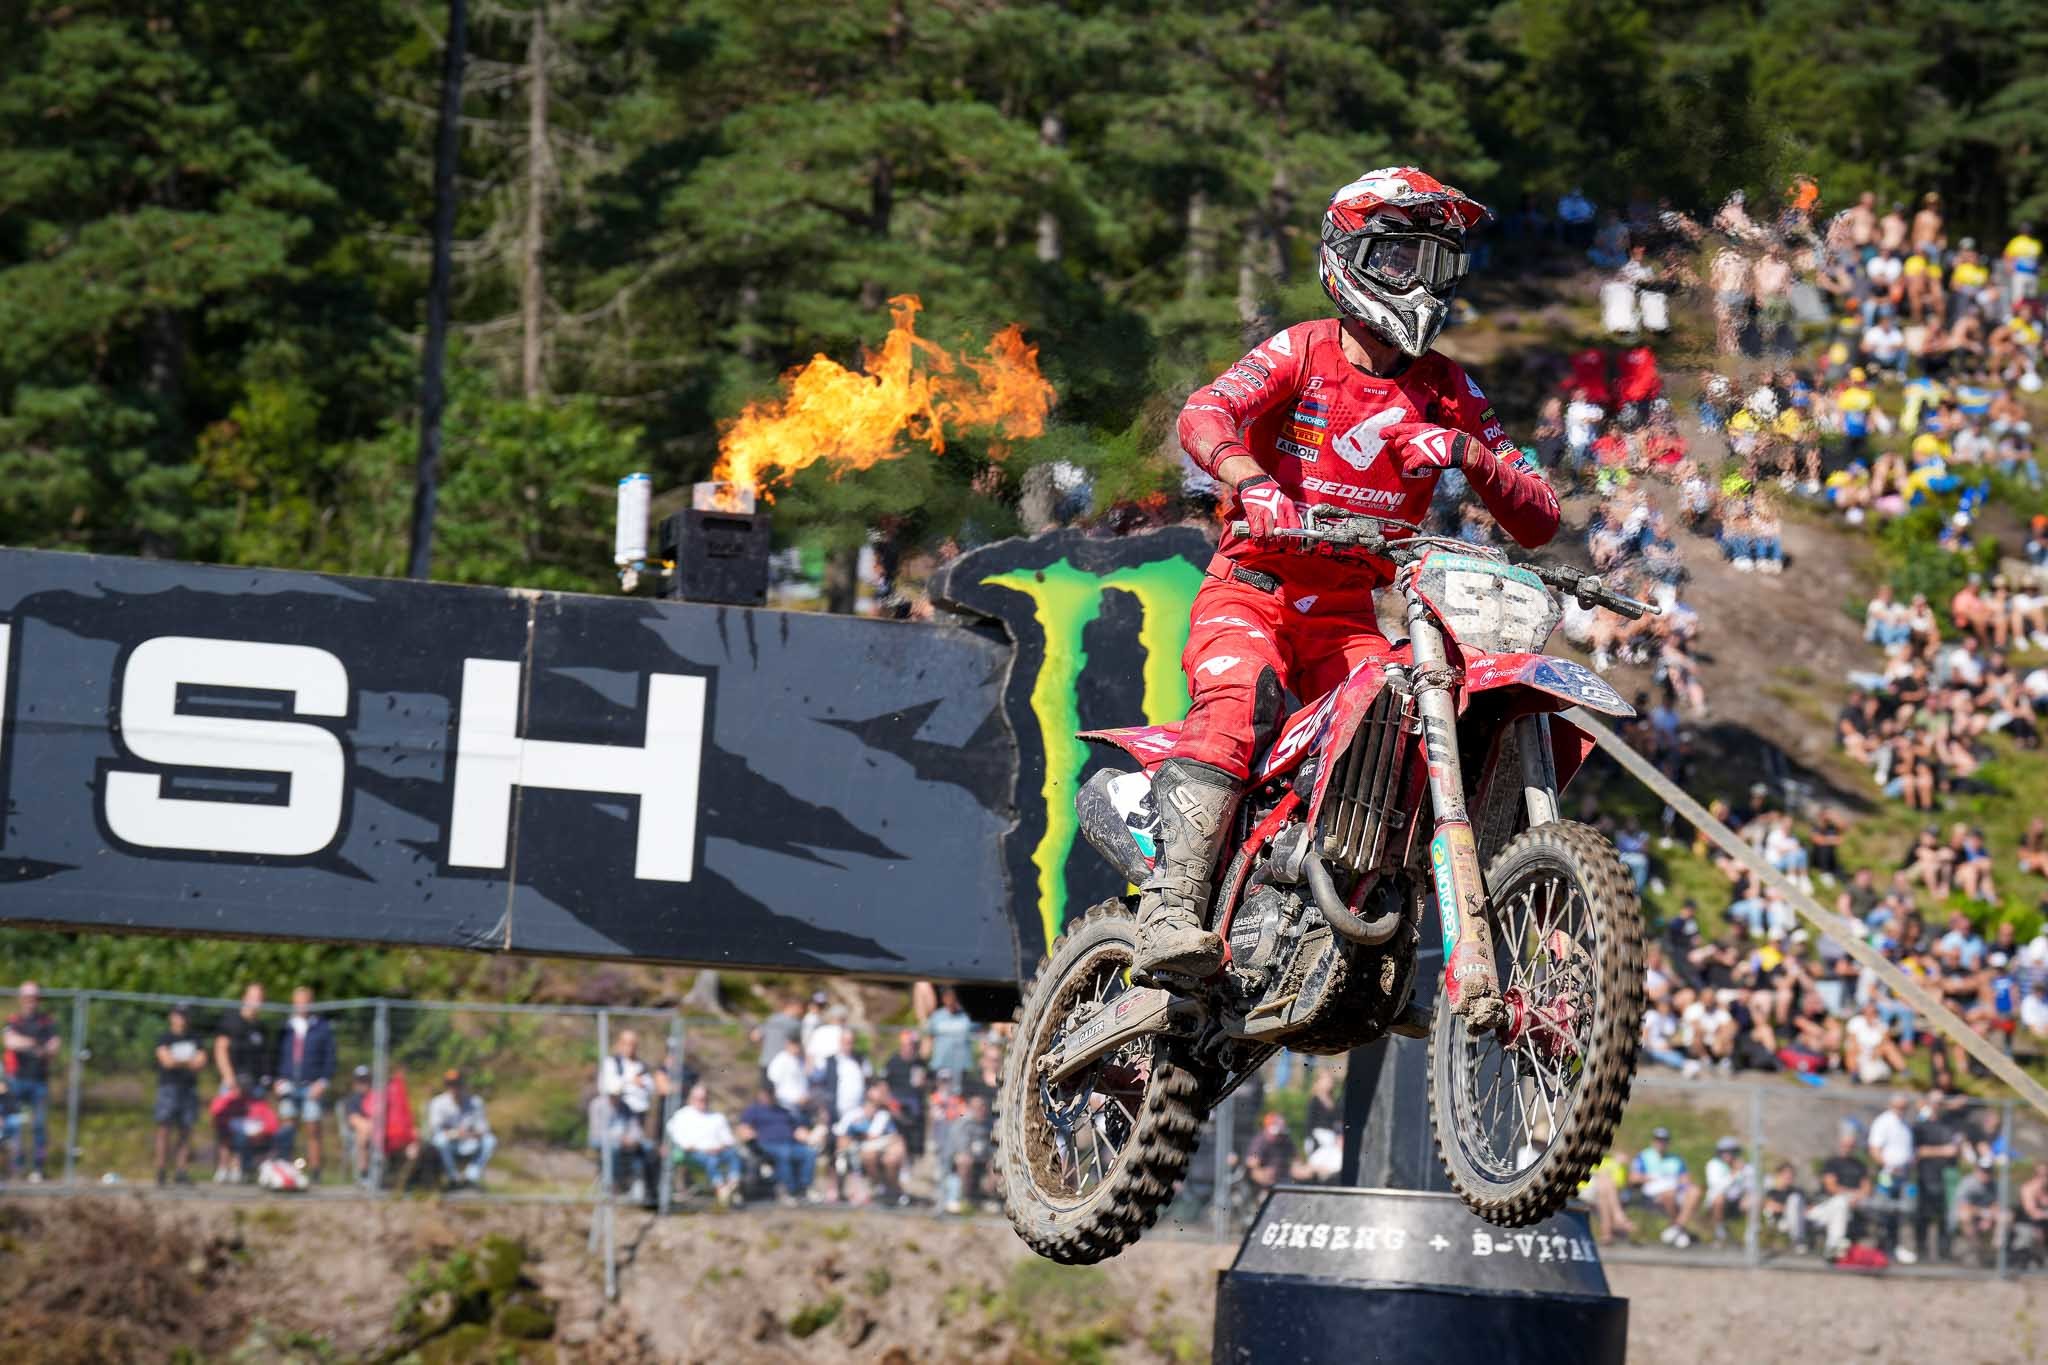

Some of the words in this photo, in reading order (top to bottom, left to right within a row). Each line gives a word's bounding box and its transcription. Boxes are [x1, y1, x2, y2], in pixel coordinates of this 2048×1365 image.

[1294, 412, 1327, 427] MOTOREX
[1278, 440, 1317, 460] AIROH
[1300, 475, 1407, 506] BEDDINI
[0, 621, 708, 883] SH
[1436, 863, 1458, 940] MOTOREX
[1261, 1220, 1407, 1250] GINSENG
